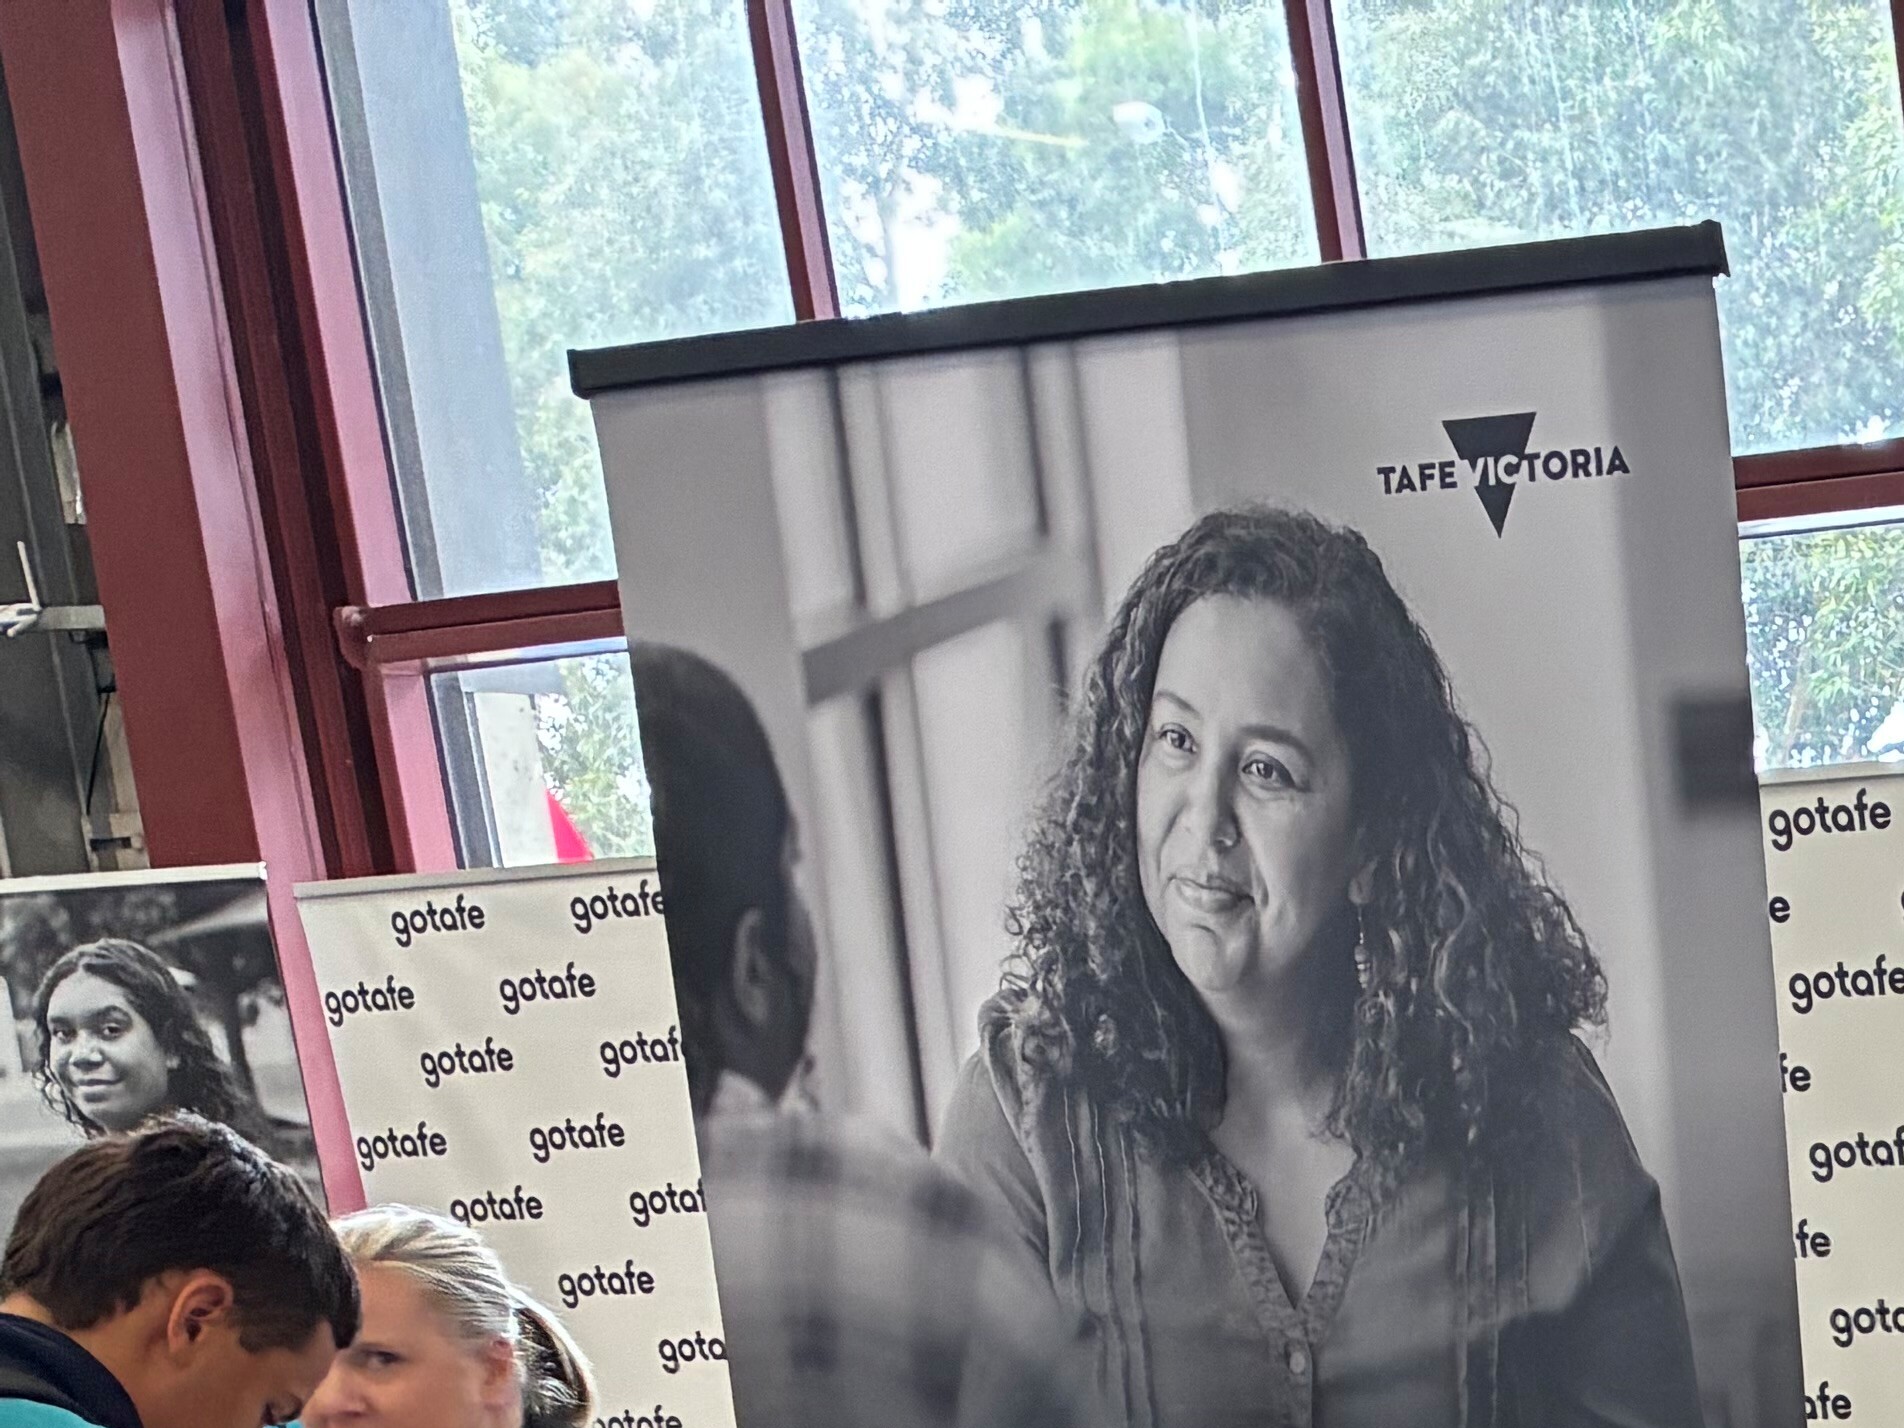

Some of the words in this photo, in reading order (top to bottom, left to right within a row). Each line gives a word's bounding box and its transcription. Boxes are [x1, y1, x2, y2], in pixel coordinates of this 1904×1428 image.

[1377, 461, 1457, 494] TAFE
[1461, 446, 1630, 486] VICTORIA
[1768, 789, 1891, 851] gotafe
[392, 895, 484, 947] gotafe
[326, 976, 414, 1026] gotafe
[559, 1260, 654, 1308] gotafe
